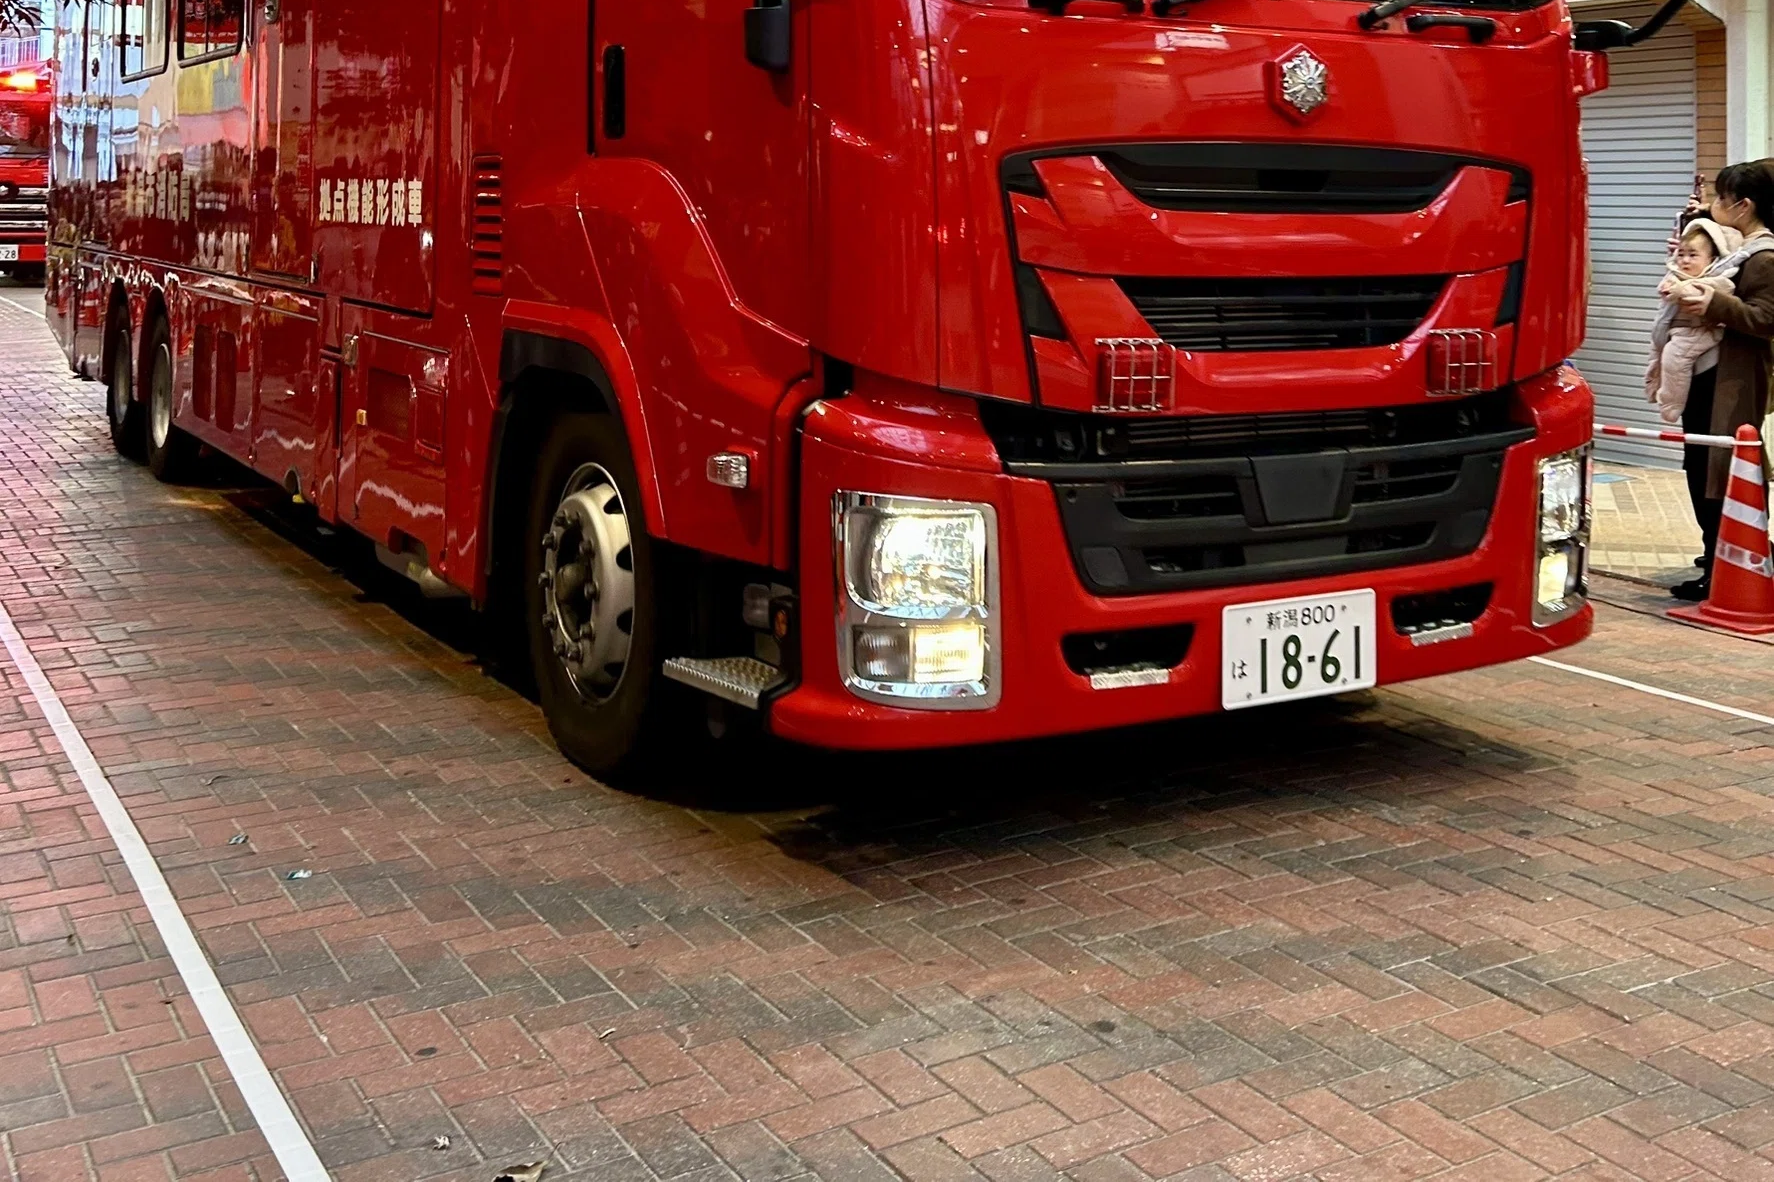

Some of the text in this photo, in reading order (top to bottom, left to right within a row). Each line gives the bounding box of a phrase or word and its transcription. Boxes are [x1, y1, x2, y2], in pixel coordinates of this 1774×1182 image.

[319, 178, 422, 227] 拠点機能形成車
[1232, 625, 1361, 694] は 18-61
